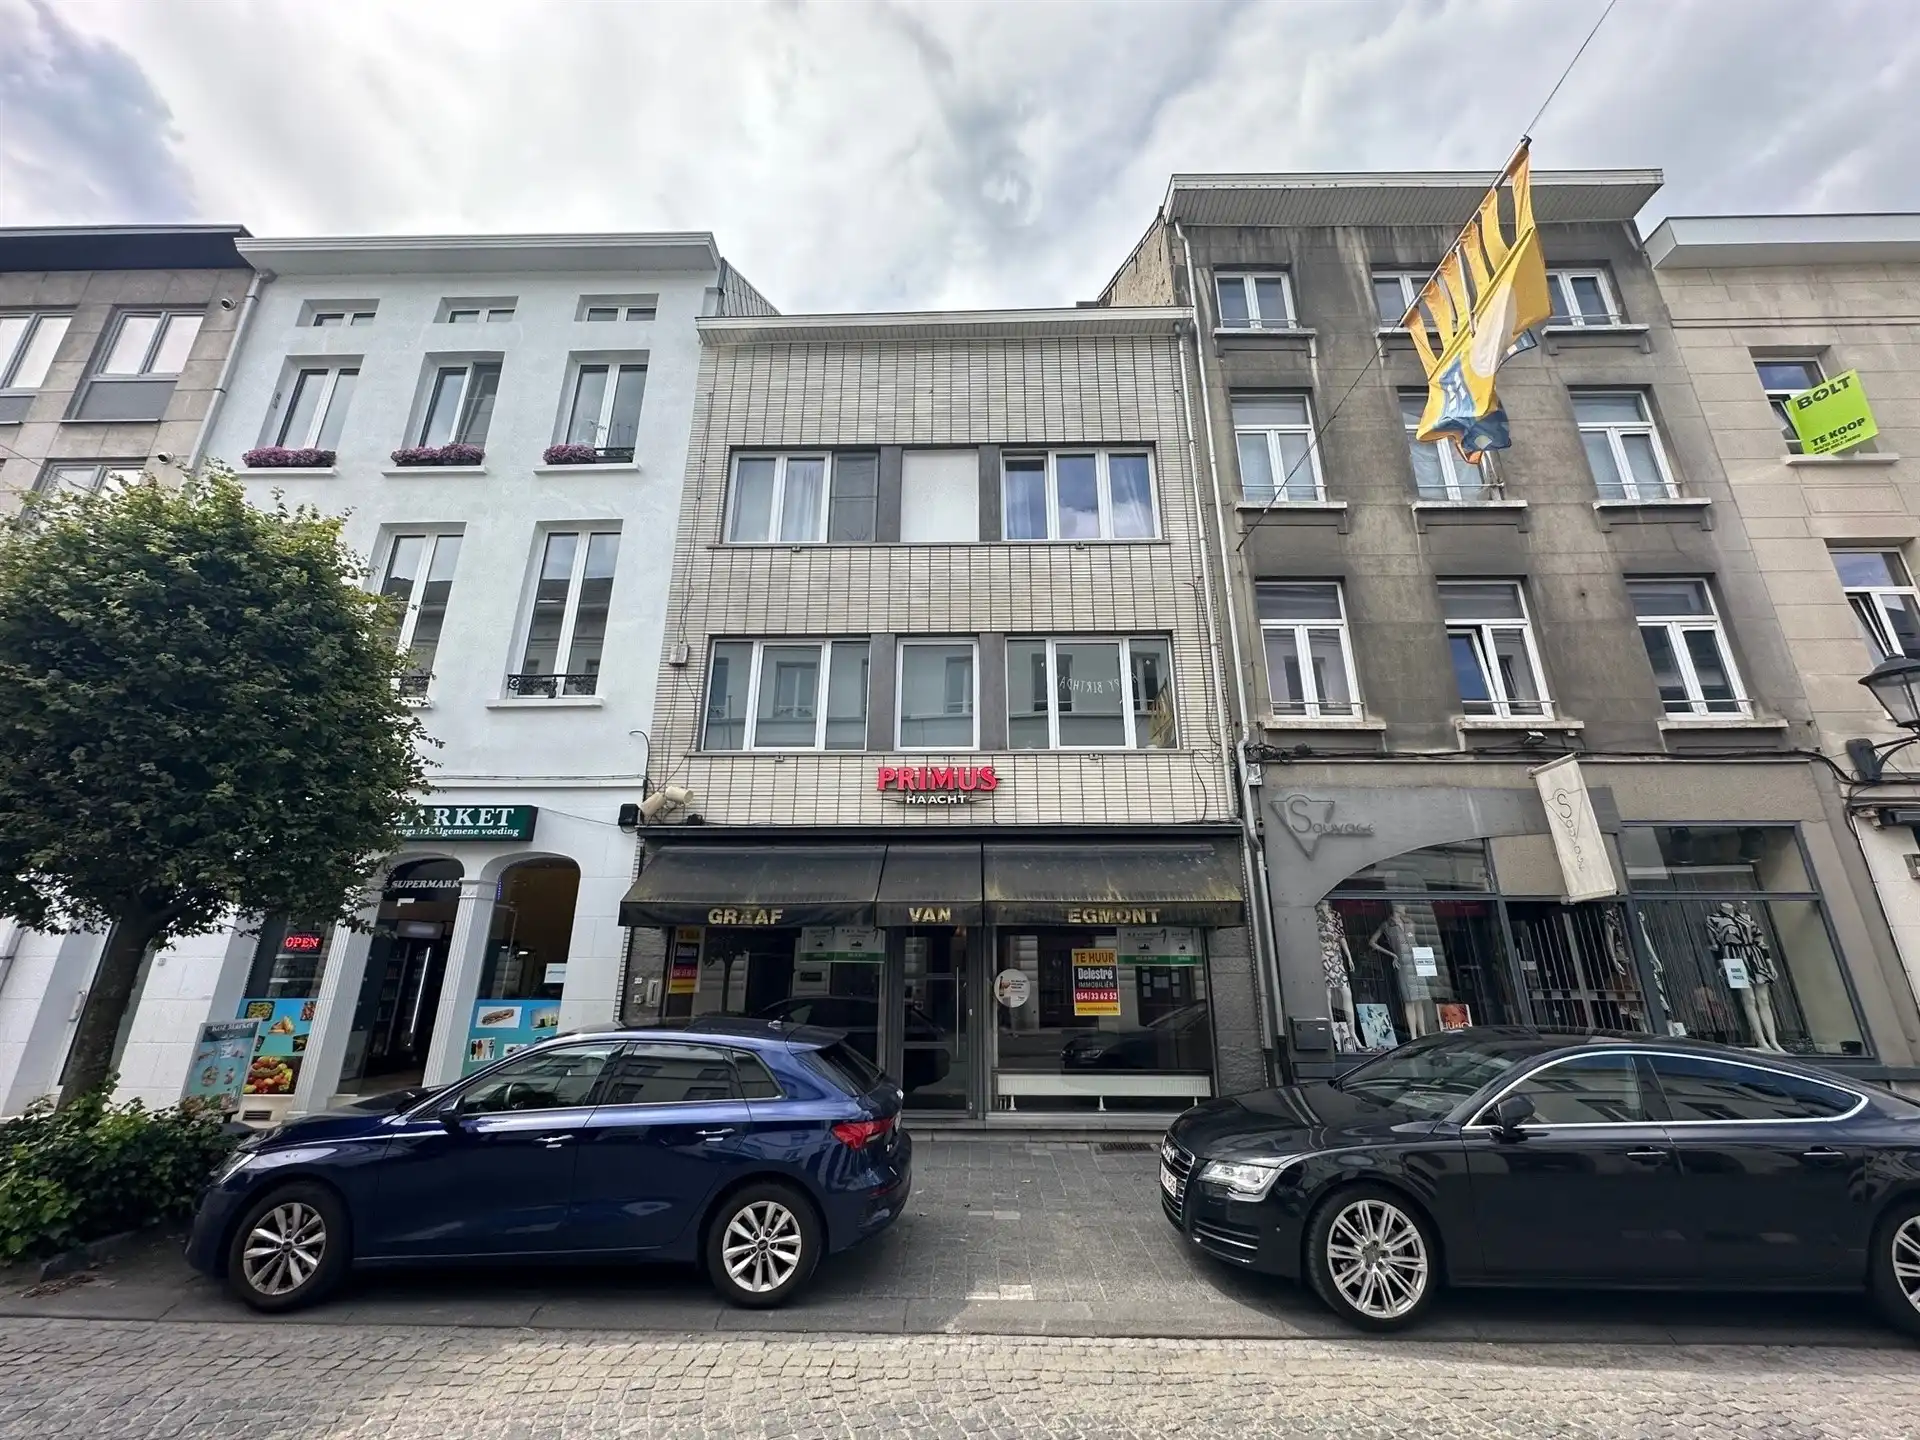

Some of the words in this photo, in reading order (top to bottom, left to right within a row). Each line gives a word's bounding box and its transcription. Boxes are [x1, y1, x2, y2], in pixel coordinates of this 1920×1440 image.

[1796, 376, 1851, 410] BOLT
[1810, 434, 1826, 446] TE
[1828, 417, 1865, 439] KOOP
[877, 766, 999, 792] PRIMUS
[906, 795, 967, 804] HAACHT
[481, 827, 519, 837] voeding
[391, 879, 461, 888] SUPERMARK
[708, 908, 783, 925] GRAAF
[908, 907, 951, 923] VAN
[1068, 908, 1160, 924] EGMONT
[285, 937, 319, 947] OPEN
[1074, 952, 1086, 963] TE
[1088, 952, 1115, 963] HUUR
[1078, 967, 1113, 980] Delestré
